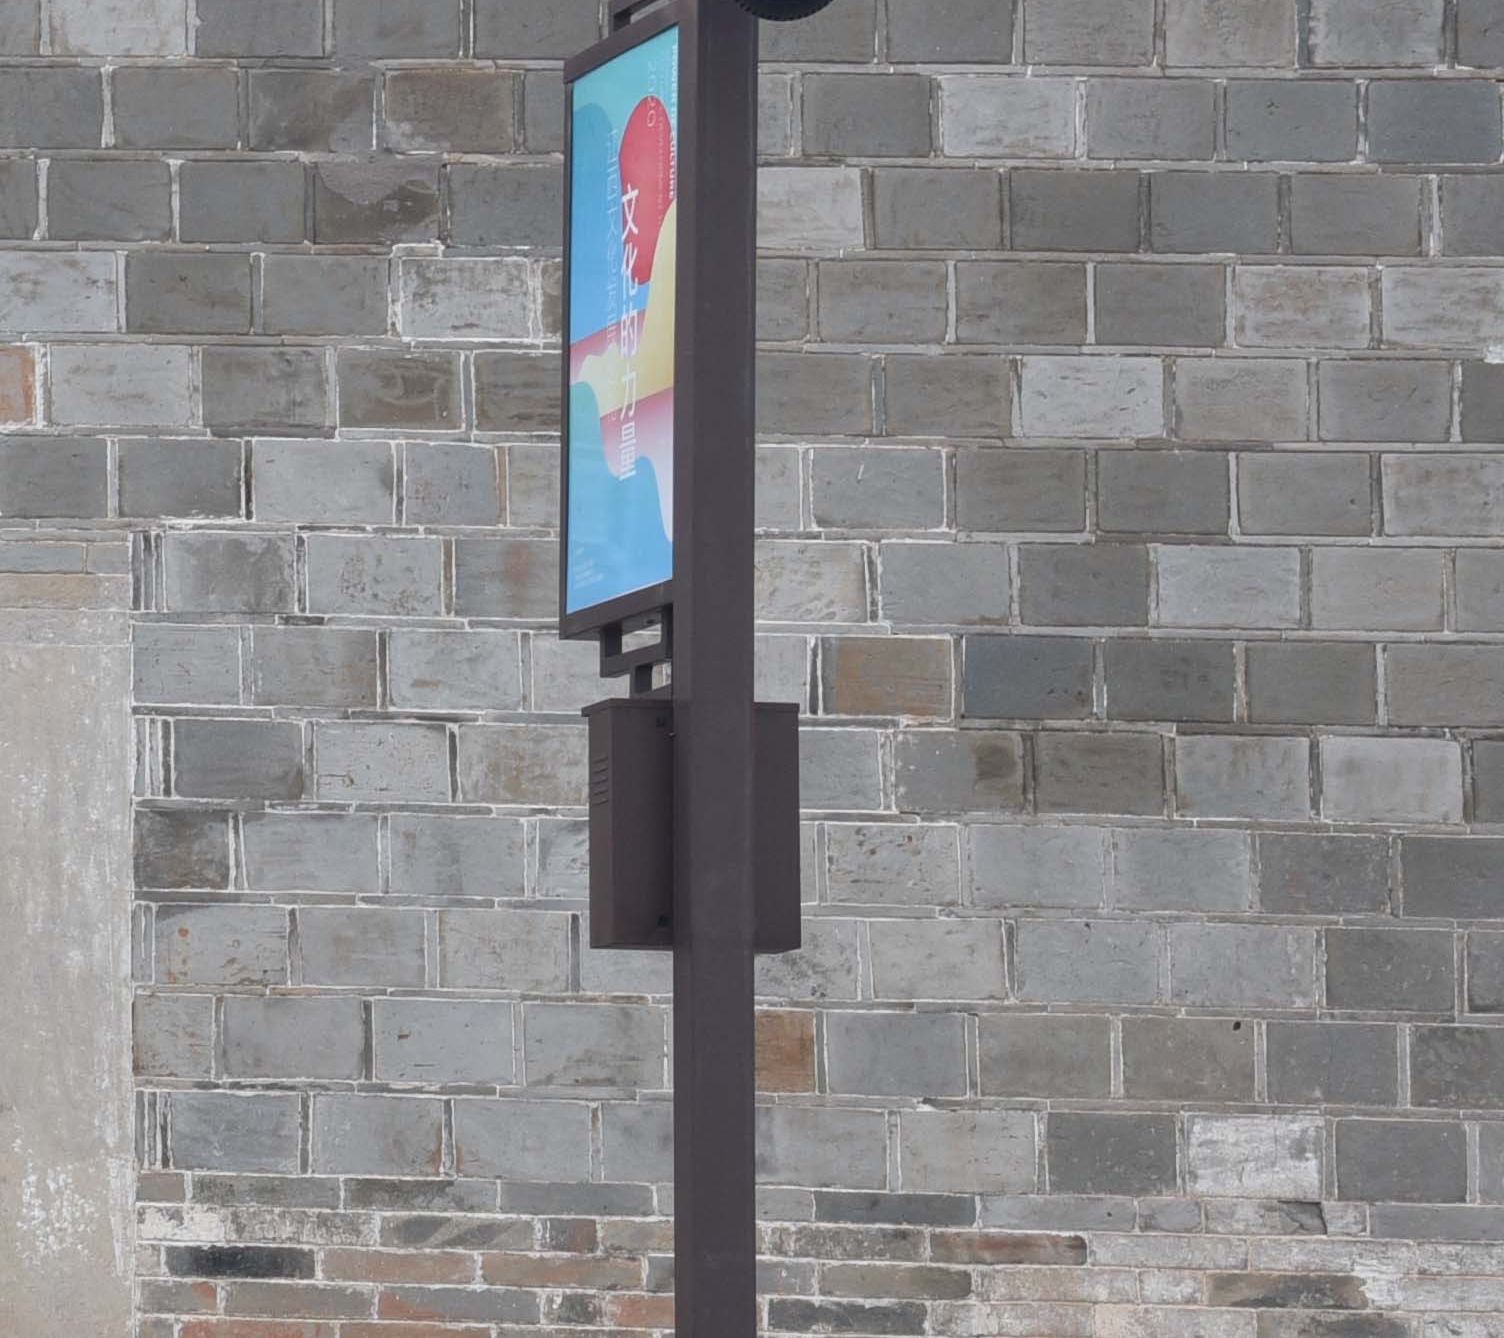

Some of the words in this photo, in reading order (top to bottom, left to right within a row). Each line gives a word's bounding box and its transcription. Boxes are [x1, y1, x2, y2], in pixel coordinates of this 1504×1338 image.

[619, 182, 640, 481] 文化的力量
